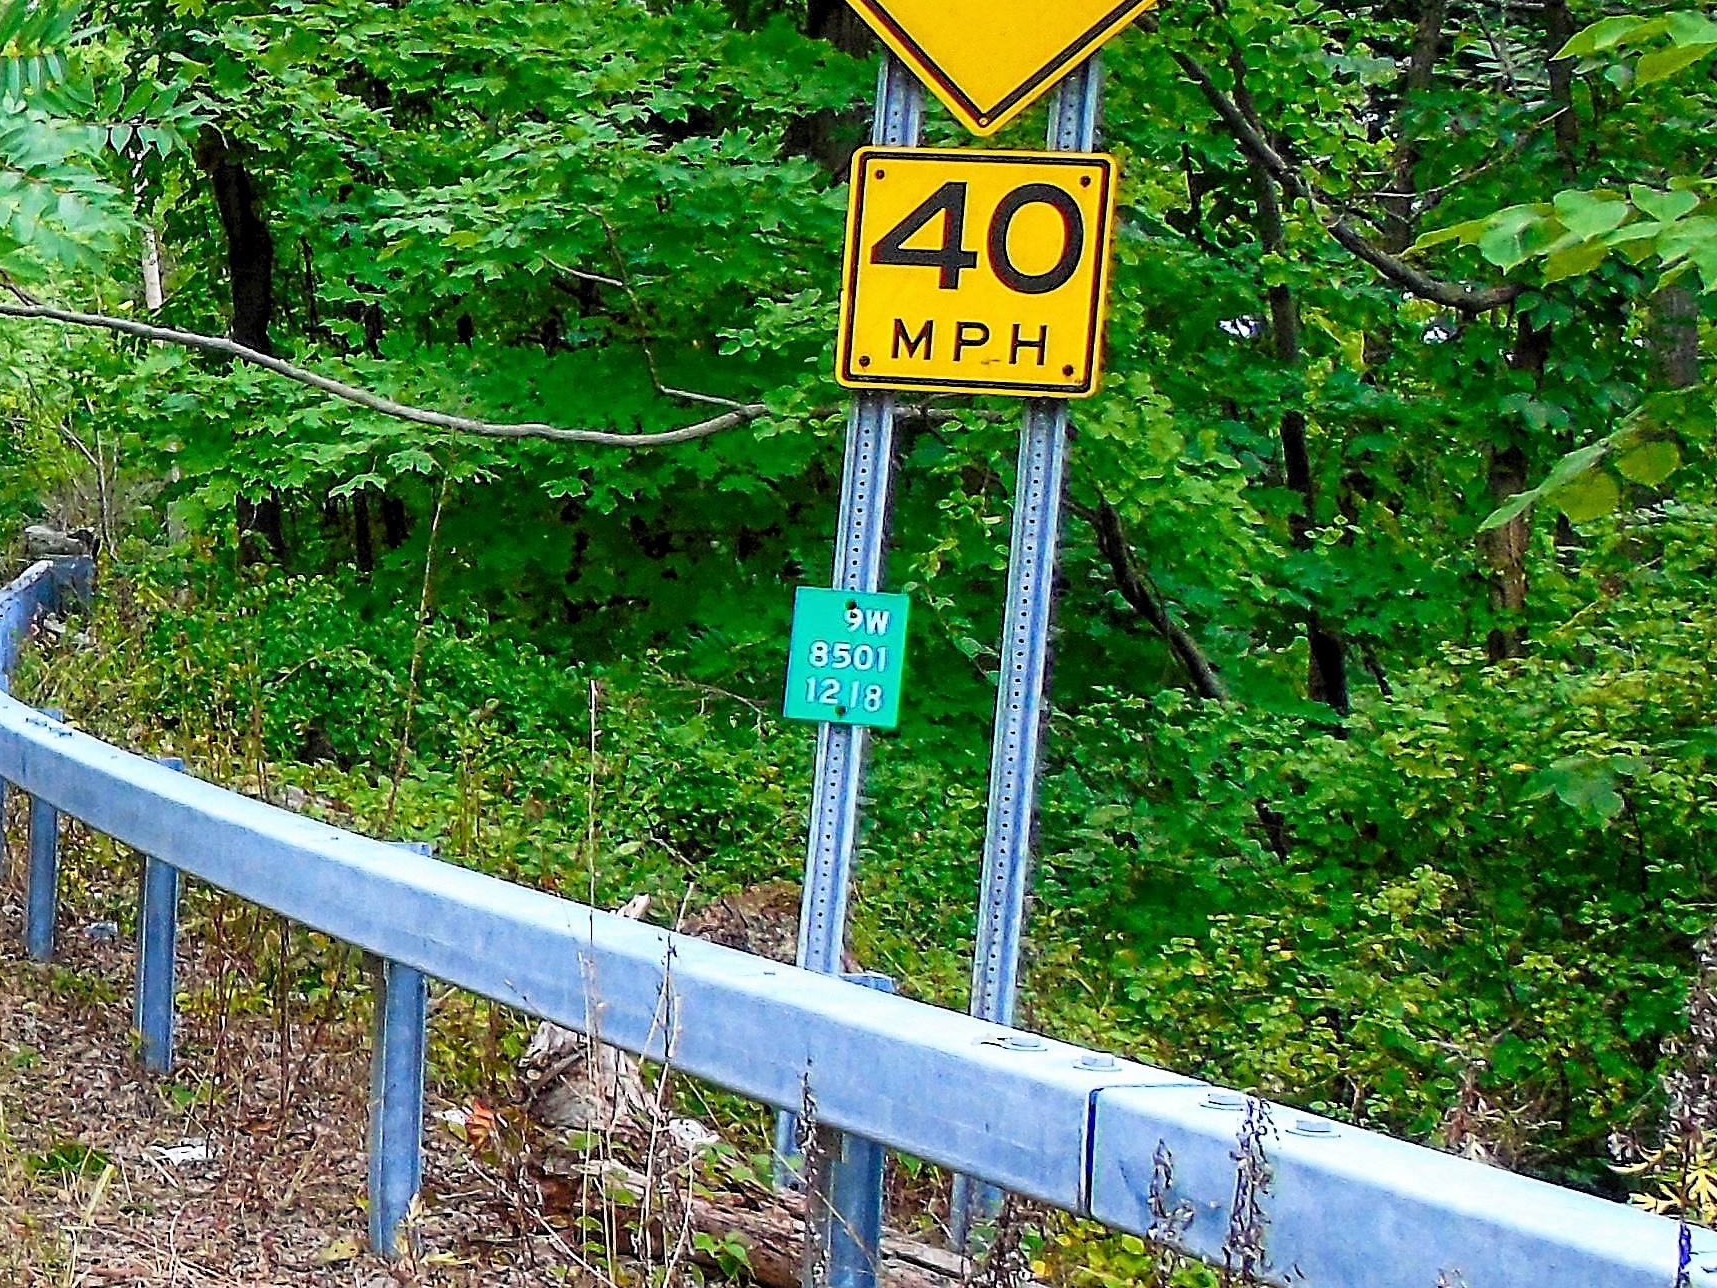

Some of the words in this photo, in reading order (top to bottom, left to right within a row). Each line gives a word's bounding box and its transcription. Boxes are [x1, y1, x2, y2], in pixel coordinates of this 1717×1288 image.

[870, 181, 1085, 295] 40
[891, 318, 1048, 367] MPH
[845, 608, 890, 636] 9W
[808, 641, 887, 672] 8501
